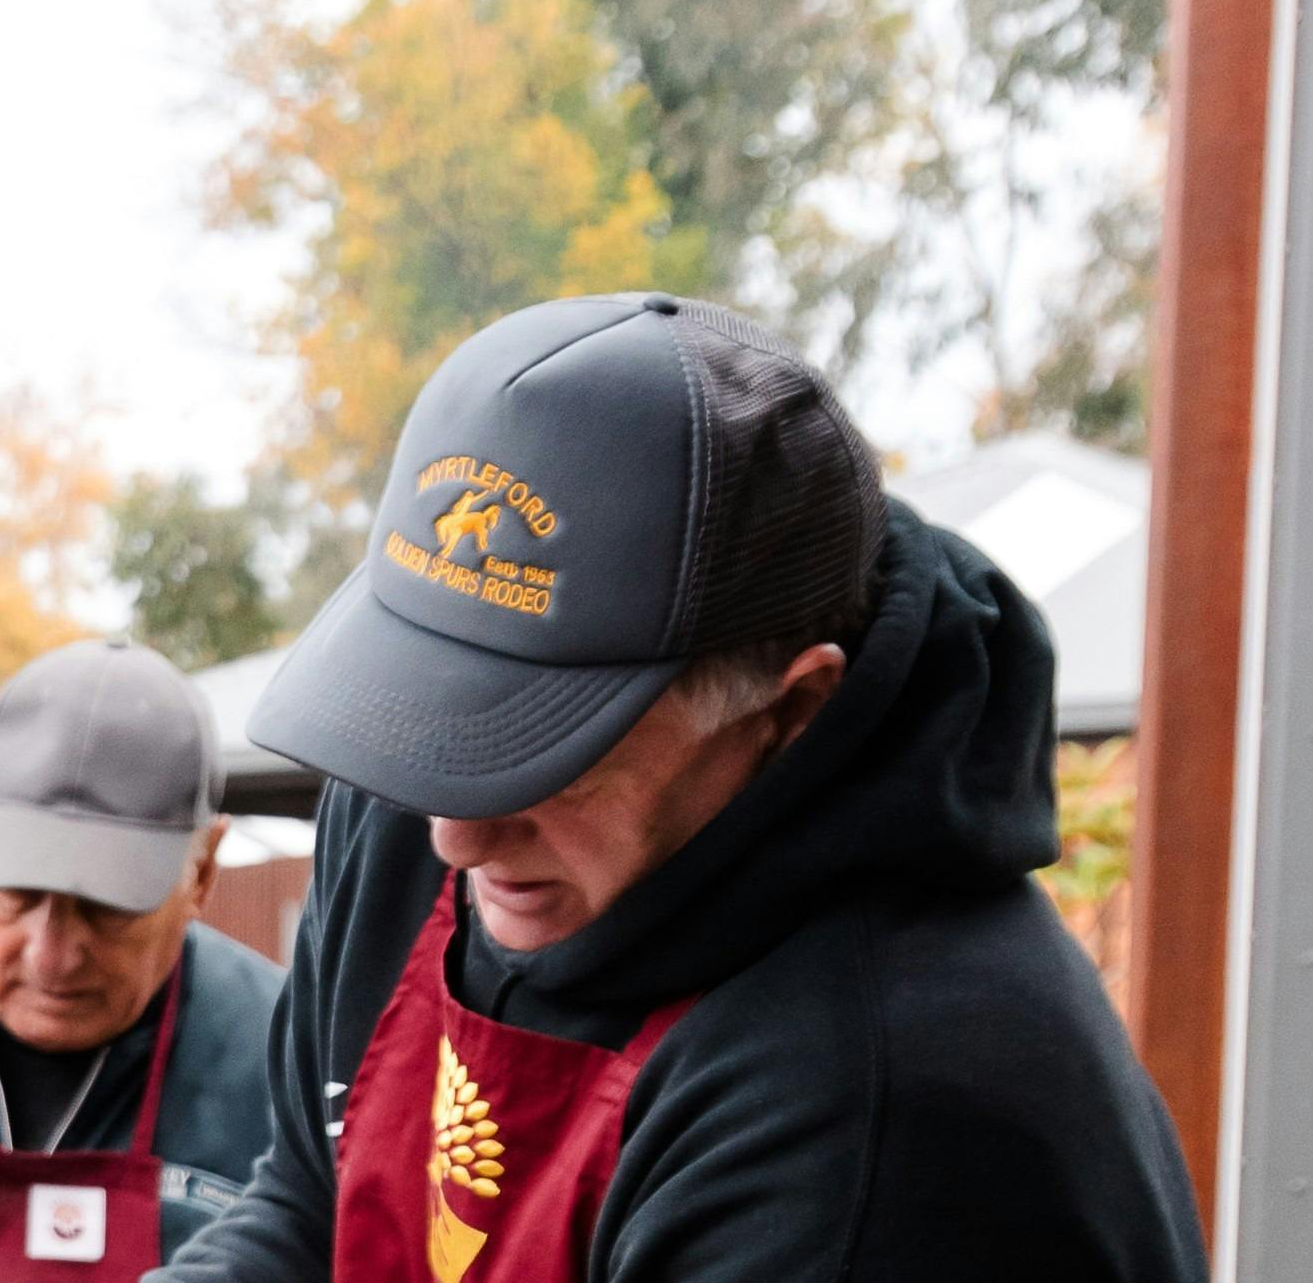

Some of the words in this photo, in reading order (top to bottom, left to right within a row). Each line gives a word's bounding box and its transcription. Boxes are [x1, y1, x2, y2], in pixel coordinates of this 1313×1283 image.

[417, 456, 557, 537] MYRTLEFORD
[428, 556, 481, 595] SPURS
[481, 576, 551, 615] RODEO
